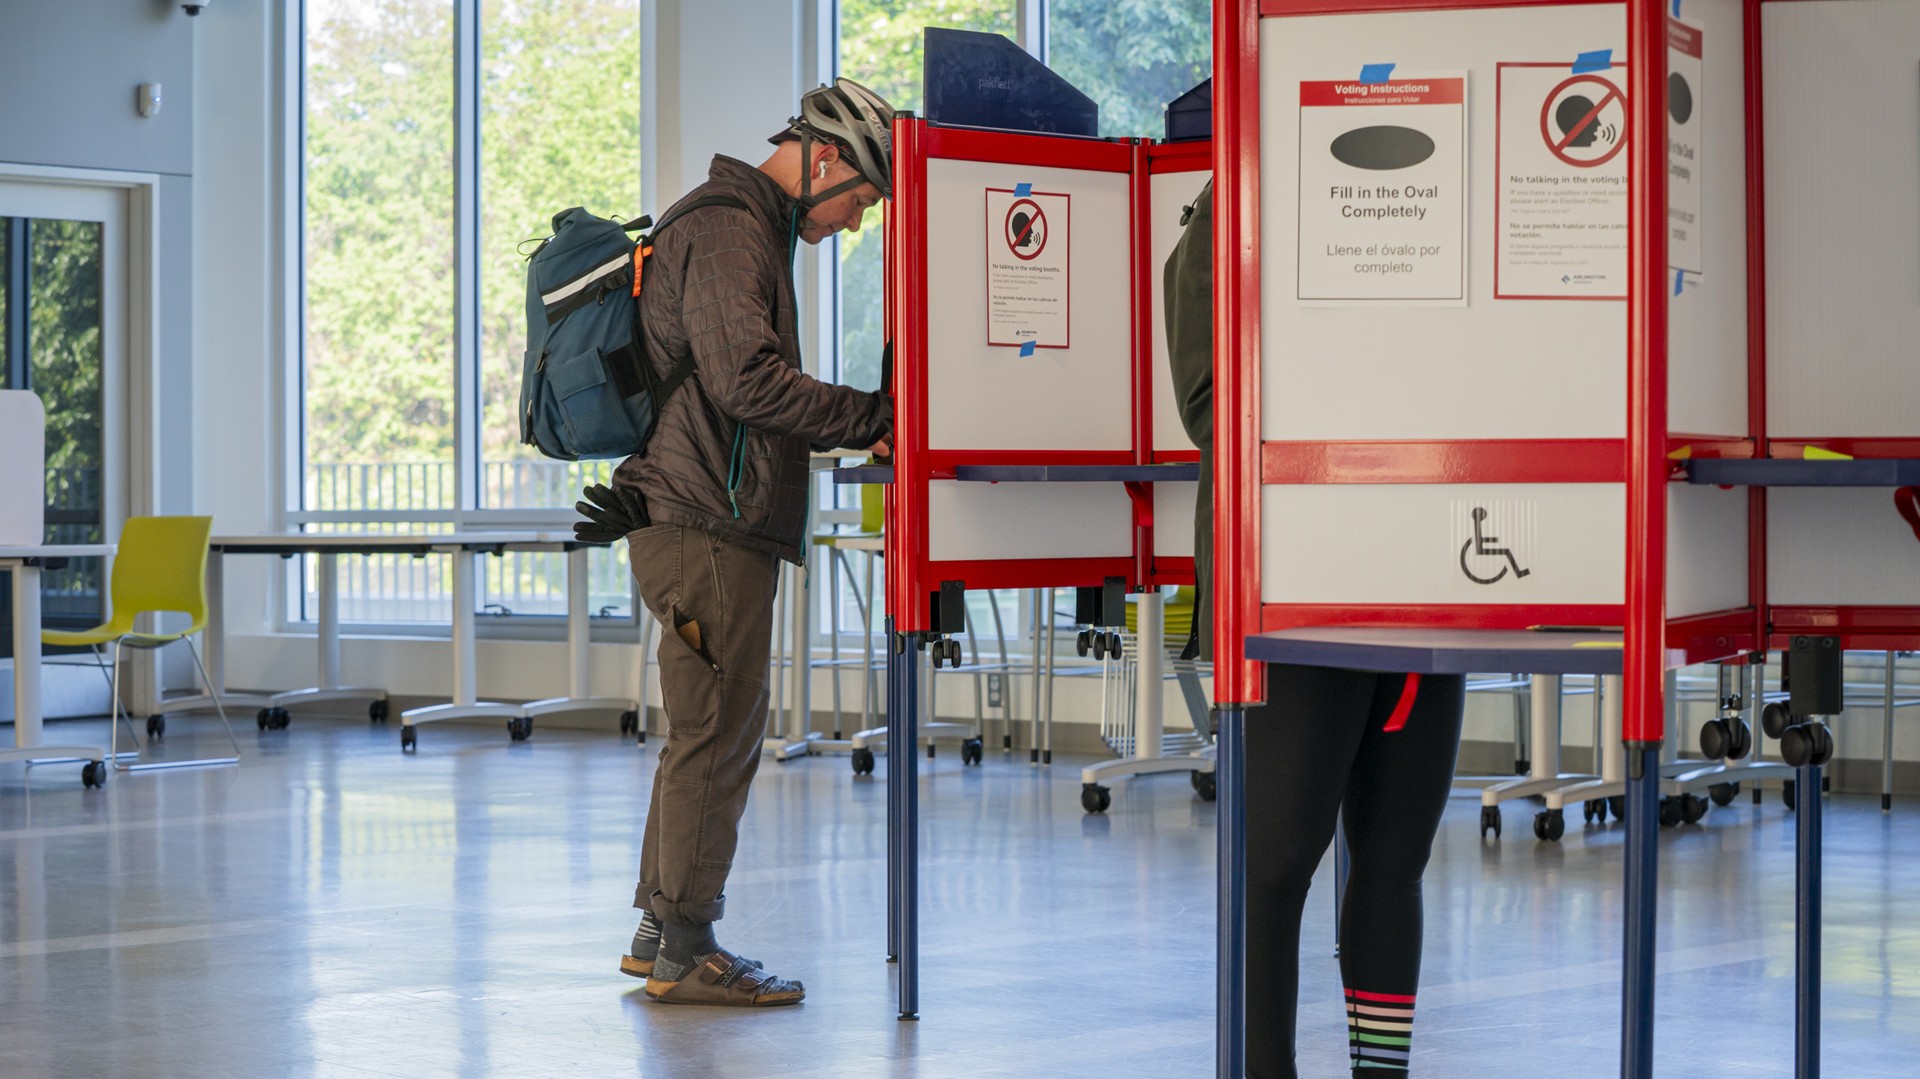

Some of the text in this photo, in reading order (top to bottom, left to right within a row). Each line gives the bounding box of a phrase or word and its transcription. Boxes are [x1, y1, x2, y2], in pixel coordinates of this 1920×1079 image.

[1335, 83, 1430, 96] Voting Instructions
[1510, 175, 1524, 184] No
[1526, 175, 1559, 185] talking
[1561, 175, 1570, 183] in
[1572, 175, 1588, 183] the
[1590, 175, 1619, 185] voting
[1330, 185, 1438, 199] Fill in the Oval
[1341, 205, 1427, 221] Completely
[1327, 244, 1441, 258] Llene el óvalo por
[1354, 261, 1413, 275] completo
